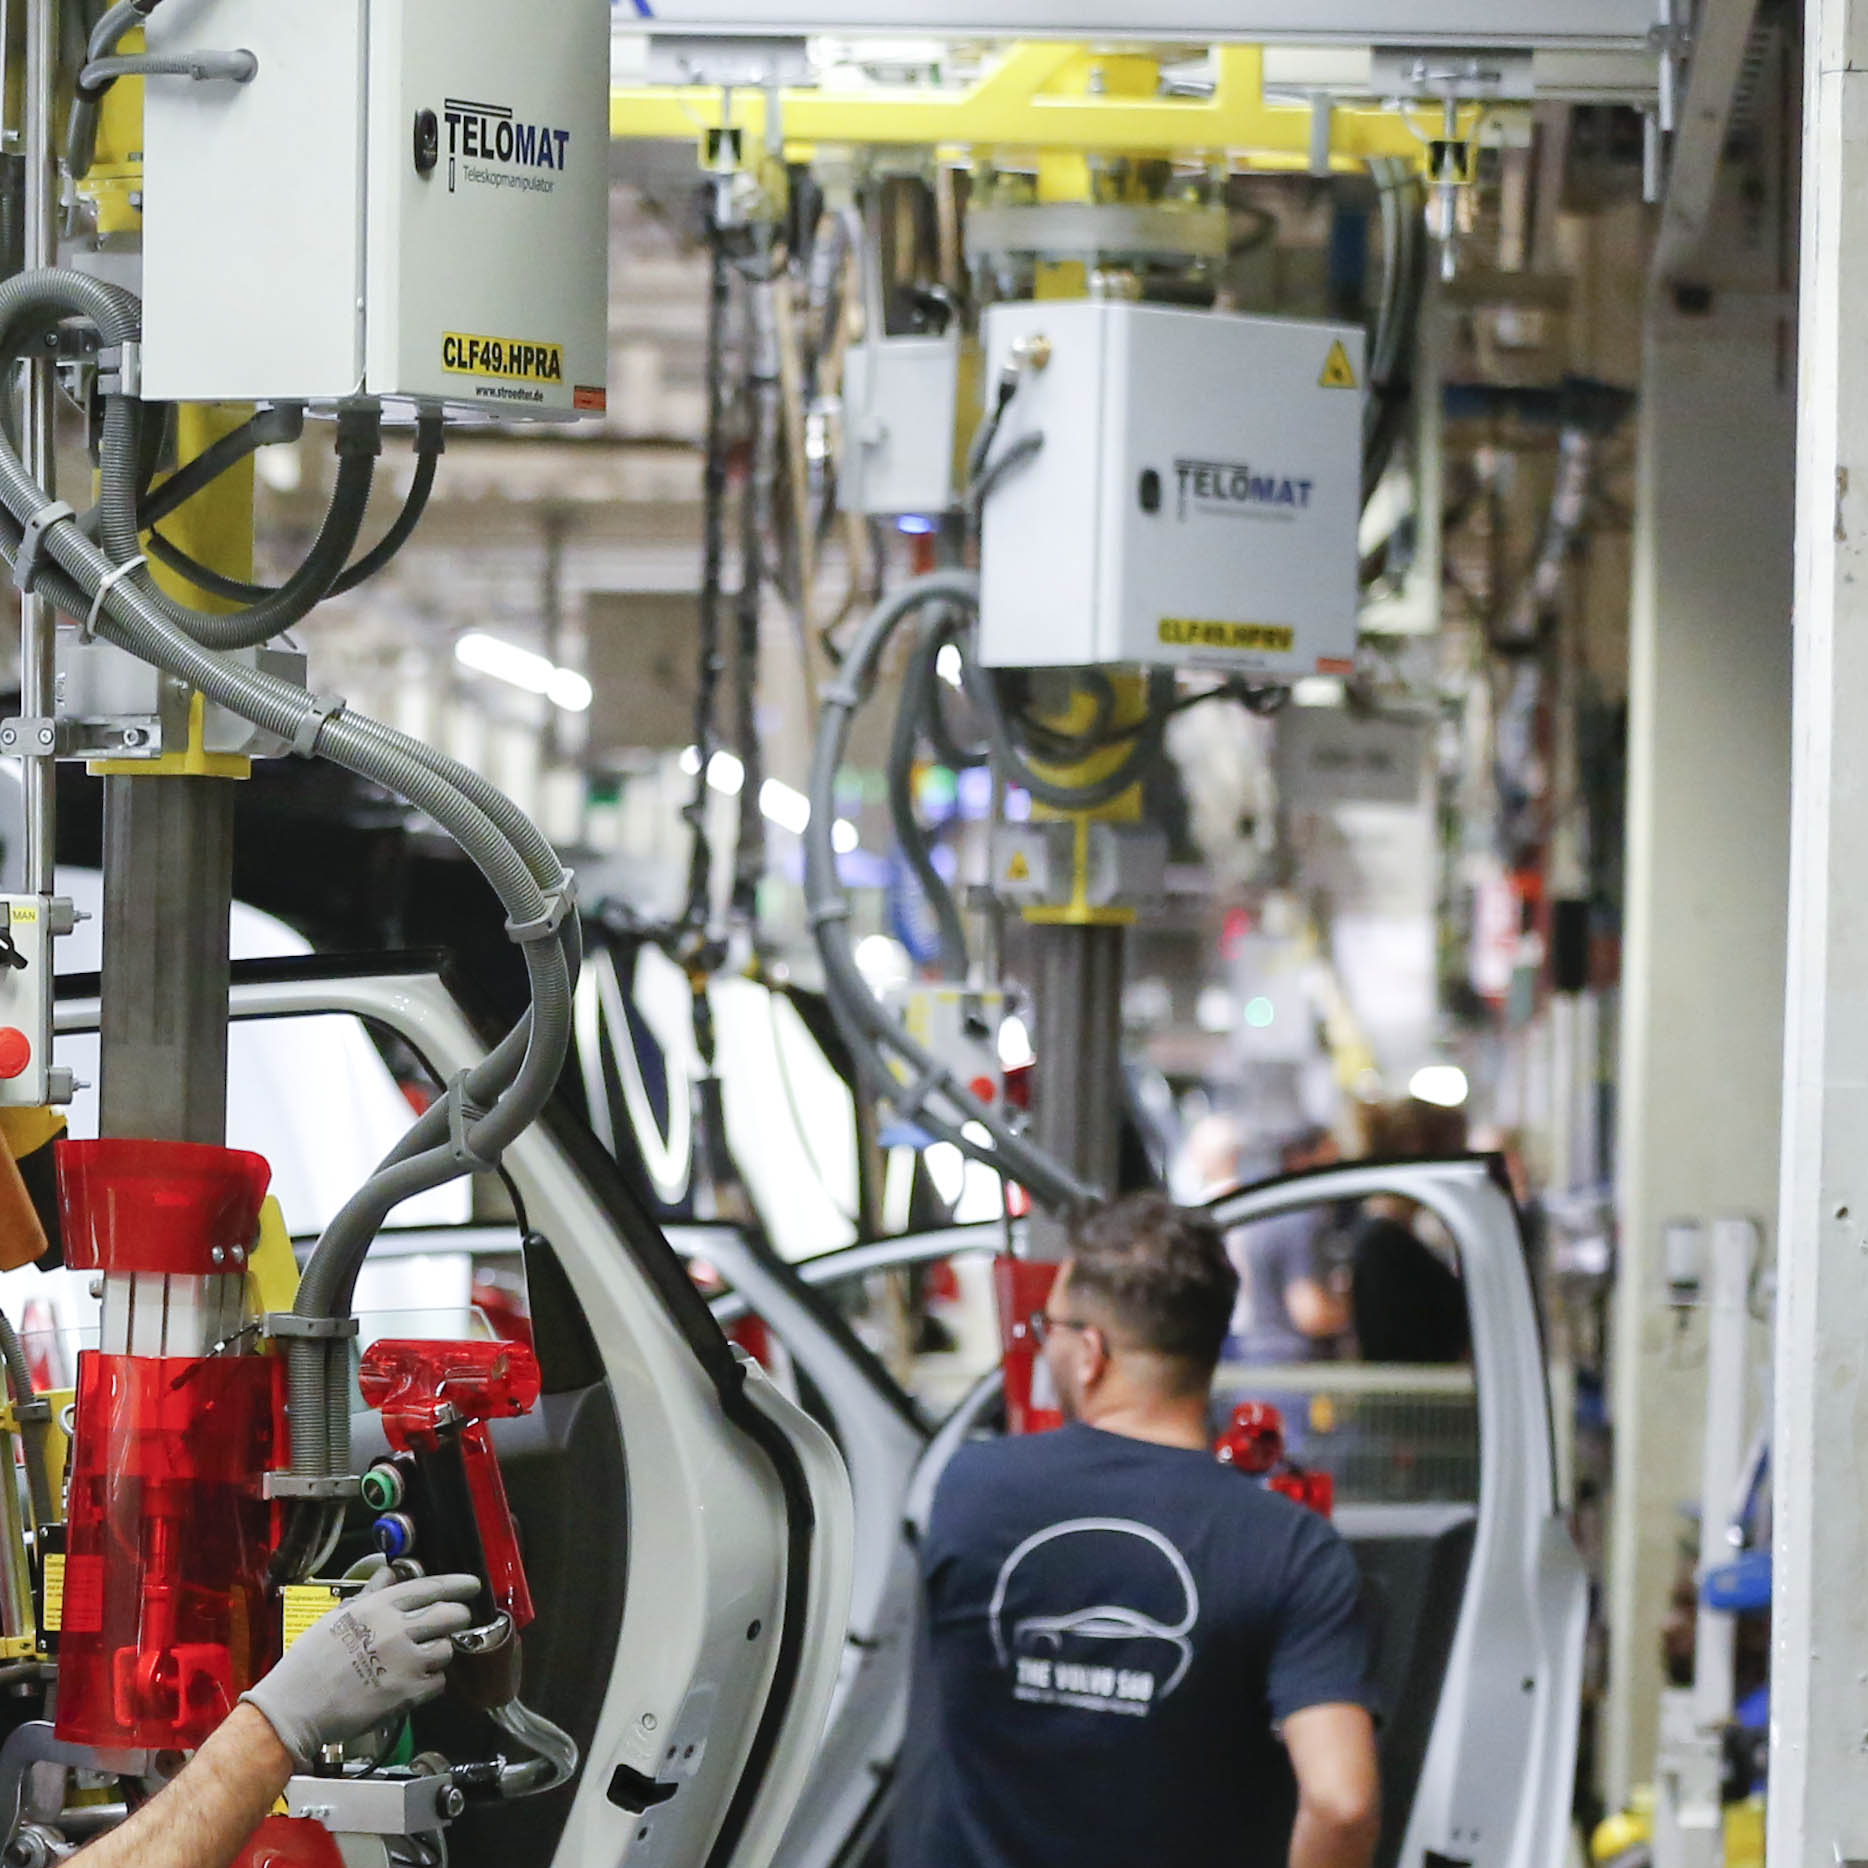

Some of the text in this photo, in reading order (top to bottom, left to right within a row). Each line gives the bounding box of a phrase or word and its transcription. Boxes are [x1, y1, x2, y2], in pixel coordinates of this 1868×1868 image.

[444, 112, 570, 171] TELOMAT
[464, 165, 556, 194] Teleskopmanipulator
[443, 336, 561, 380] CLF49.HPRA
[1175, 466, 1313, 508] TELOMAT
[12, 910, 36, 921] MAN
